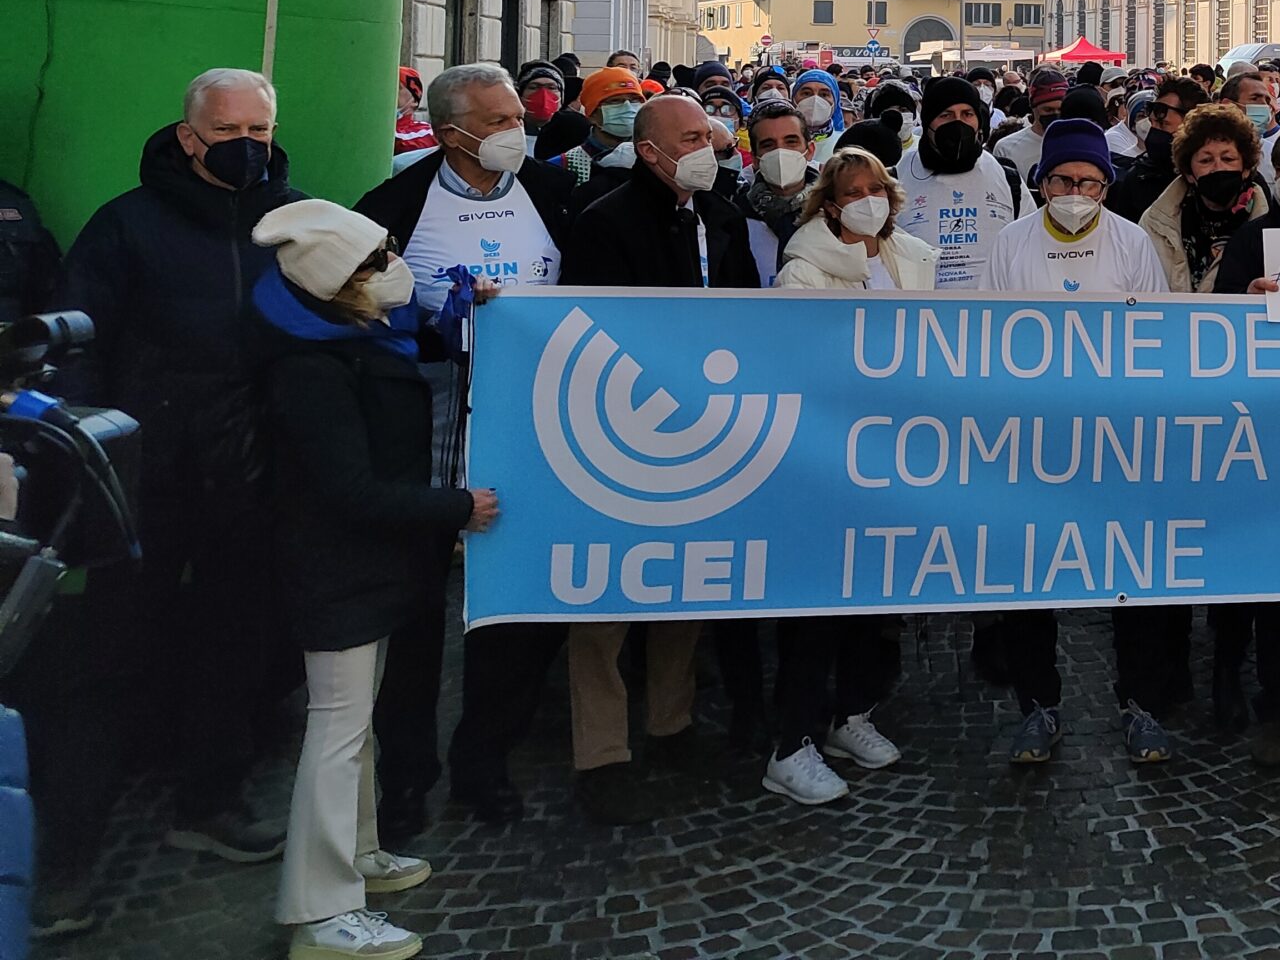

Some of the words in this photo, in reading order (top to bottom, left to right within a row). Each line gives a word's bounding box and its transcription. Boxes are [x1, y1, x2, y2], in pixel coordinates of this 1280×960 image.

[458, 210, 515, 222] GIVOVA
[939, 208, 977, 219] RUN
[938, 219, 978, 234] FOR
[939, 233, 978, 244] MEM
[1047, 250, 1094, 259] GIVOVA
[853, 308, 1164, 378] UNIONE
[846, 401, 1268, 488] COMUNITÀ
[842, 519, 1206, 599] ITALIANE
[550, 539, 768, 605] UCEI
